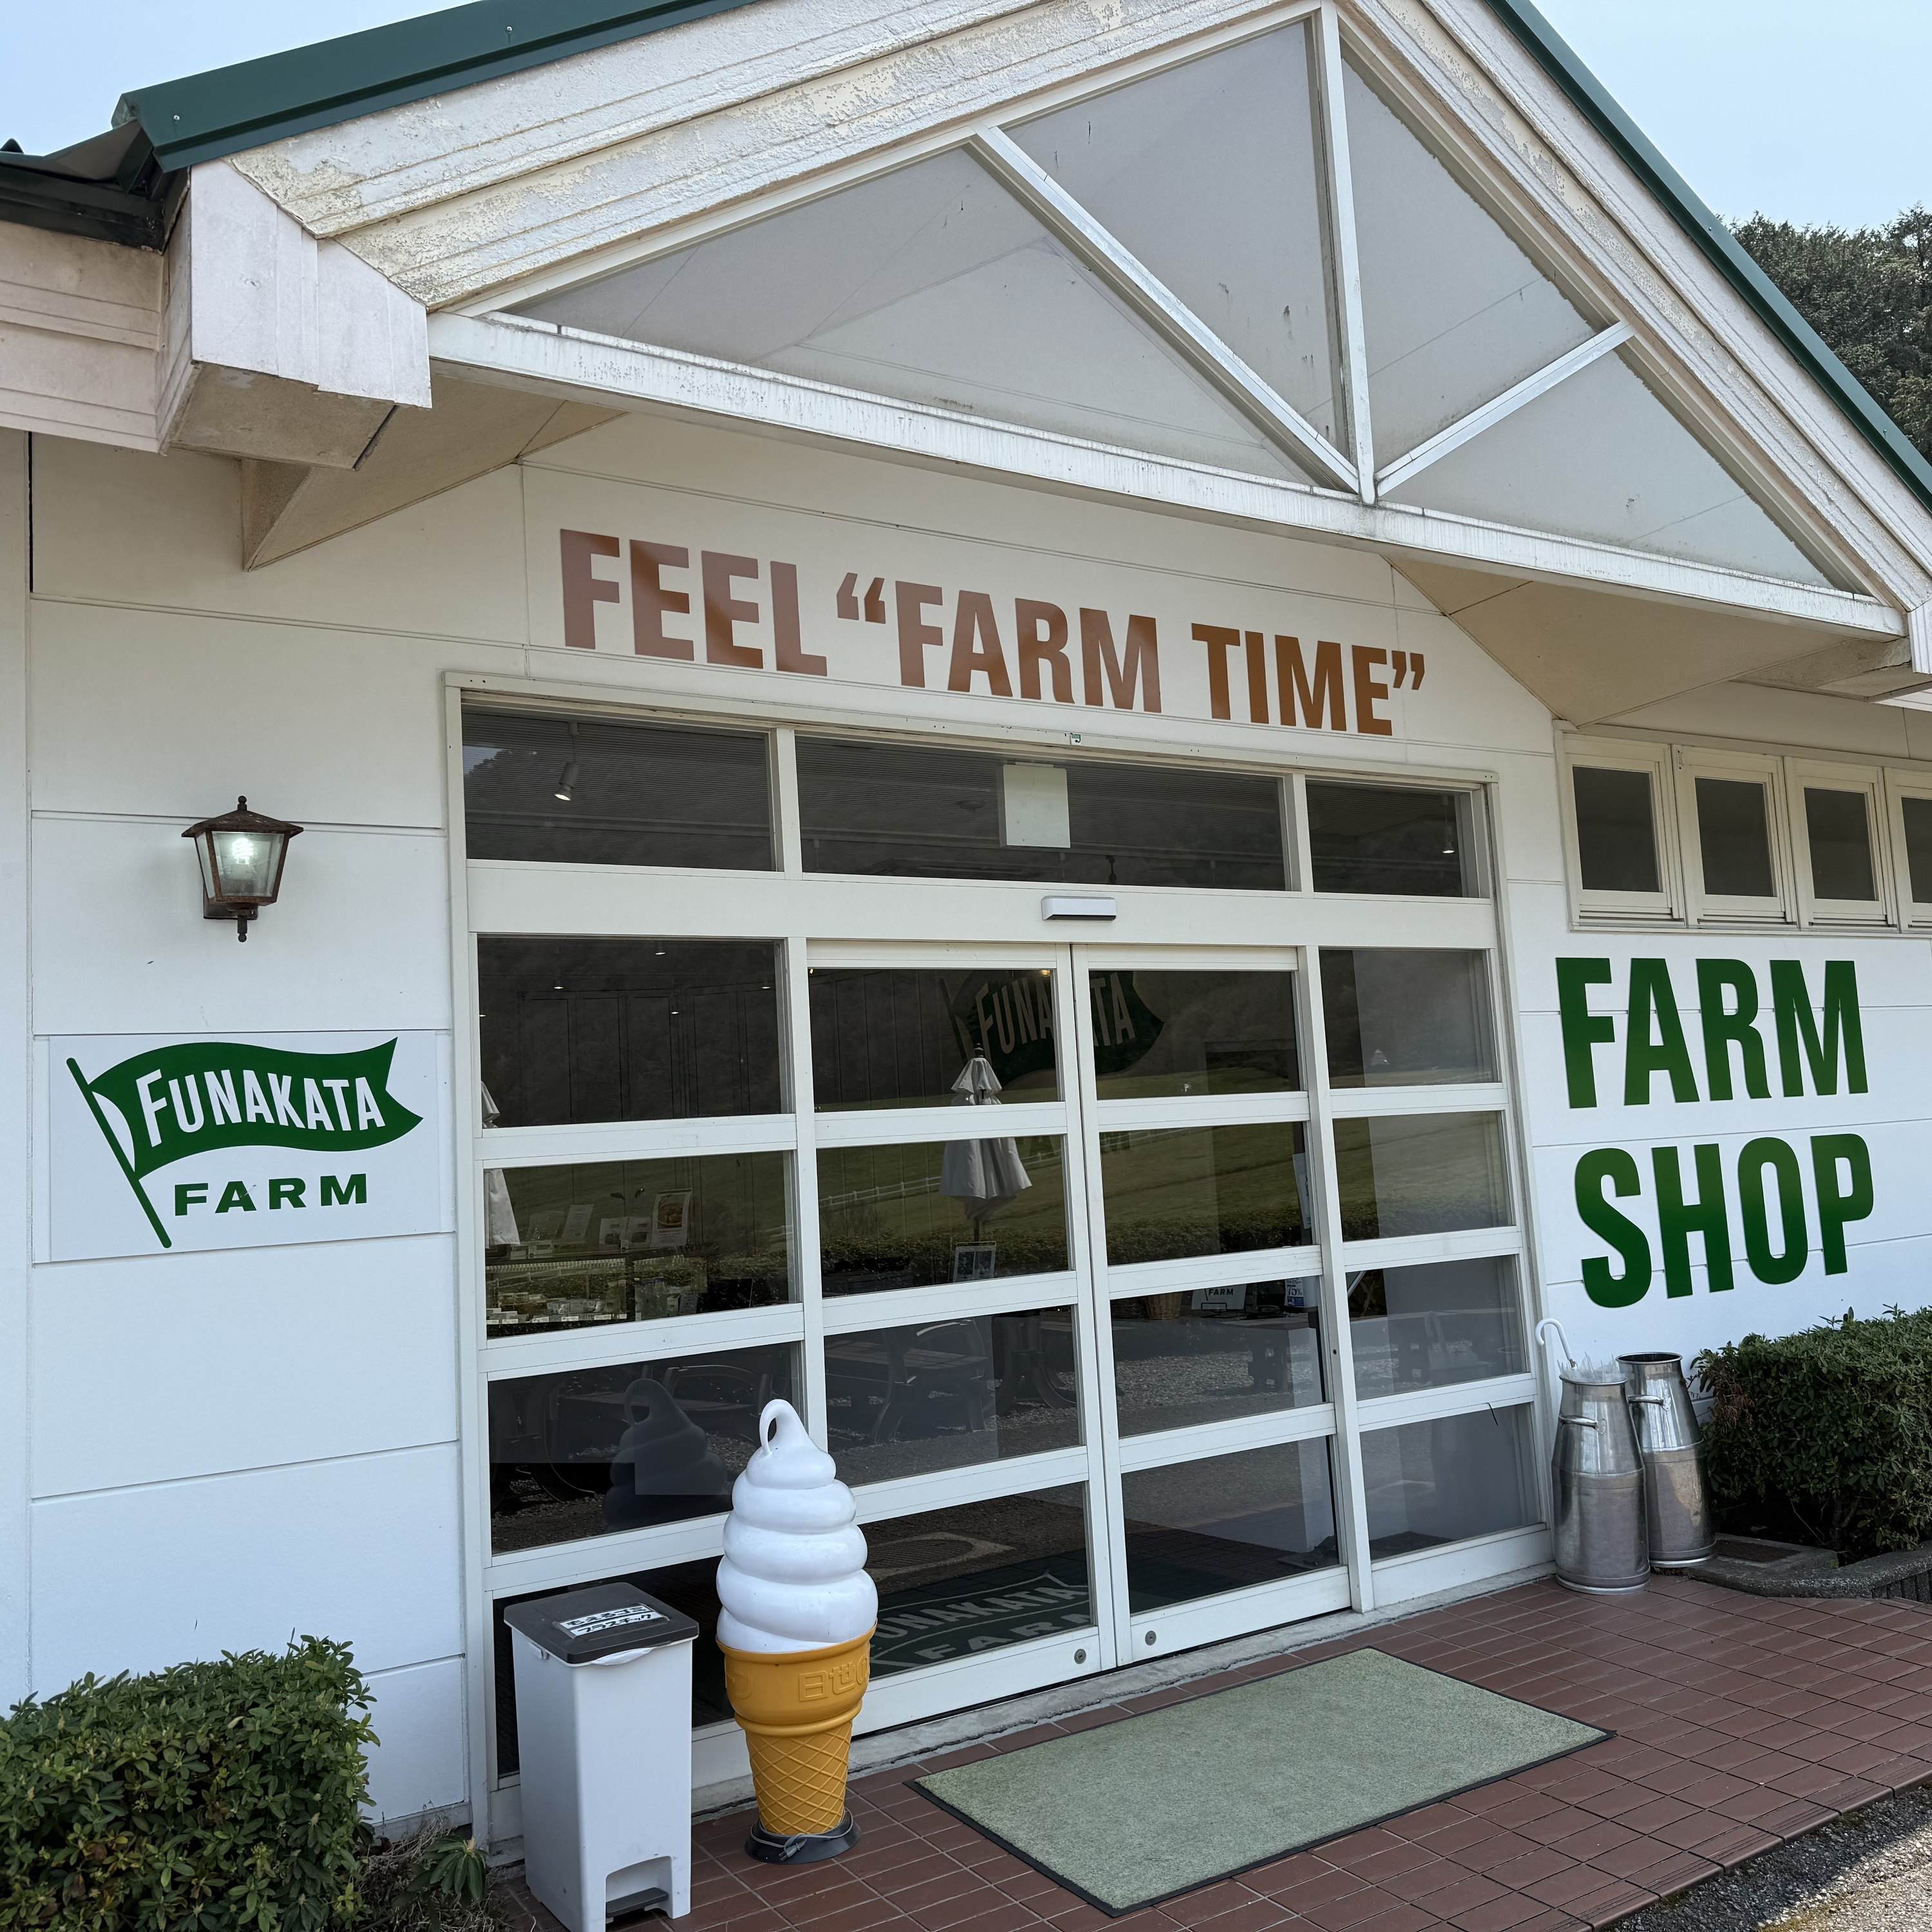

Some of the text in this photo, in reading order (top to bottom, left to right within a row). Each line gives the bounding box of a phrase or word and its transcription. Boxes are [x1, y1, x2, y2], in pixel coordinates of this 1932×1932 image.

[560, 529, 827, 676] FEEL
[975, 972, 1135, 1065] FUNATA
[1555, 958, 1868, 1109] FARM
[135, 1069, 386, 1148] FUNAKATA
[175, 1173, 368, 1216] FARM
[1575, 1133, 1874, 1308] SHOP
[1287, 1284, 1303, 1296] 75%
[871, 1587, 1090, 1650] UNAKATA
